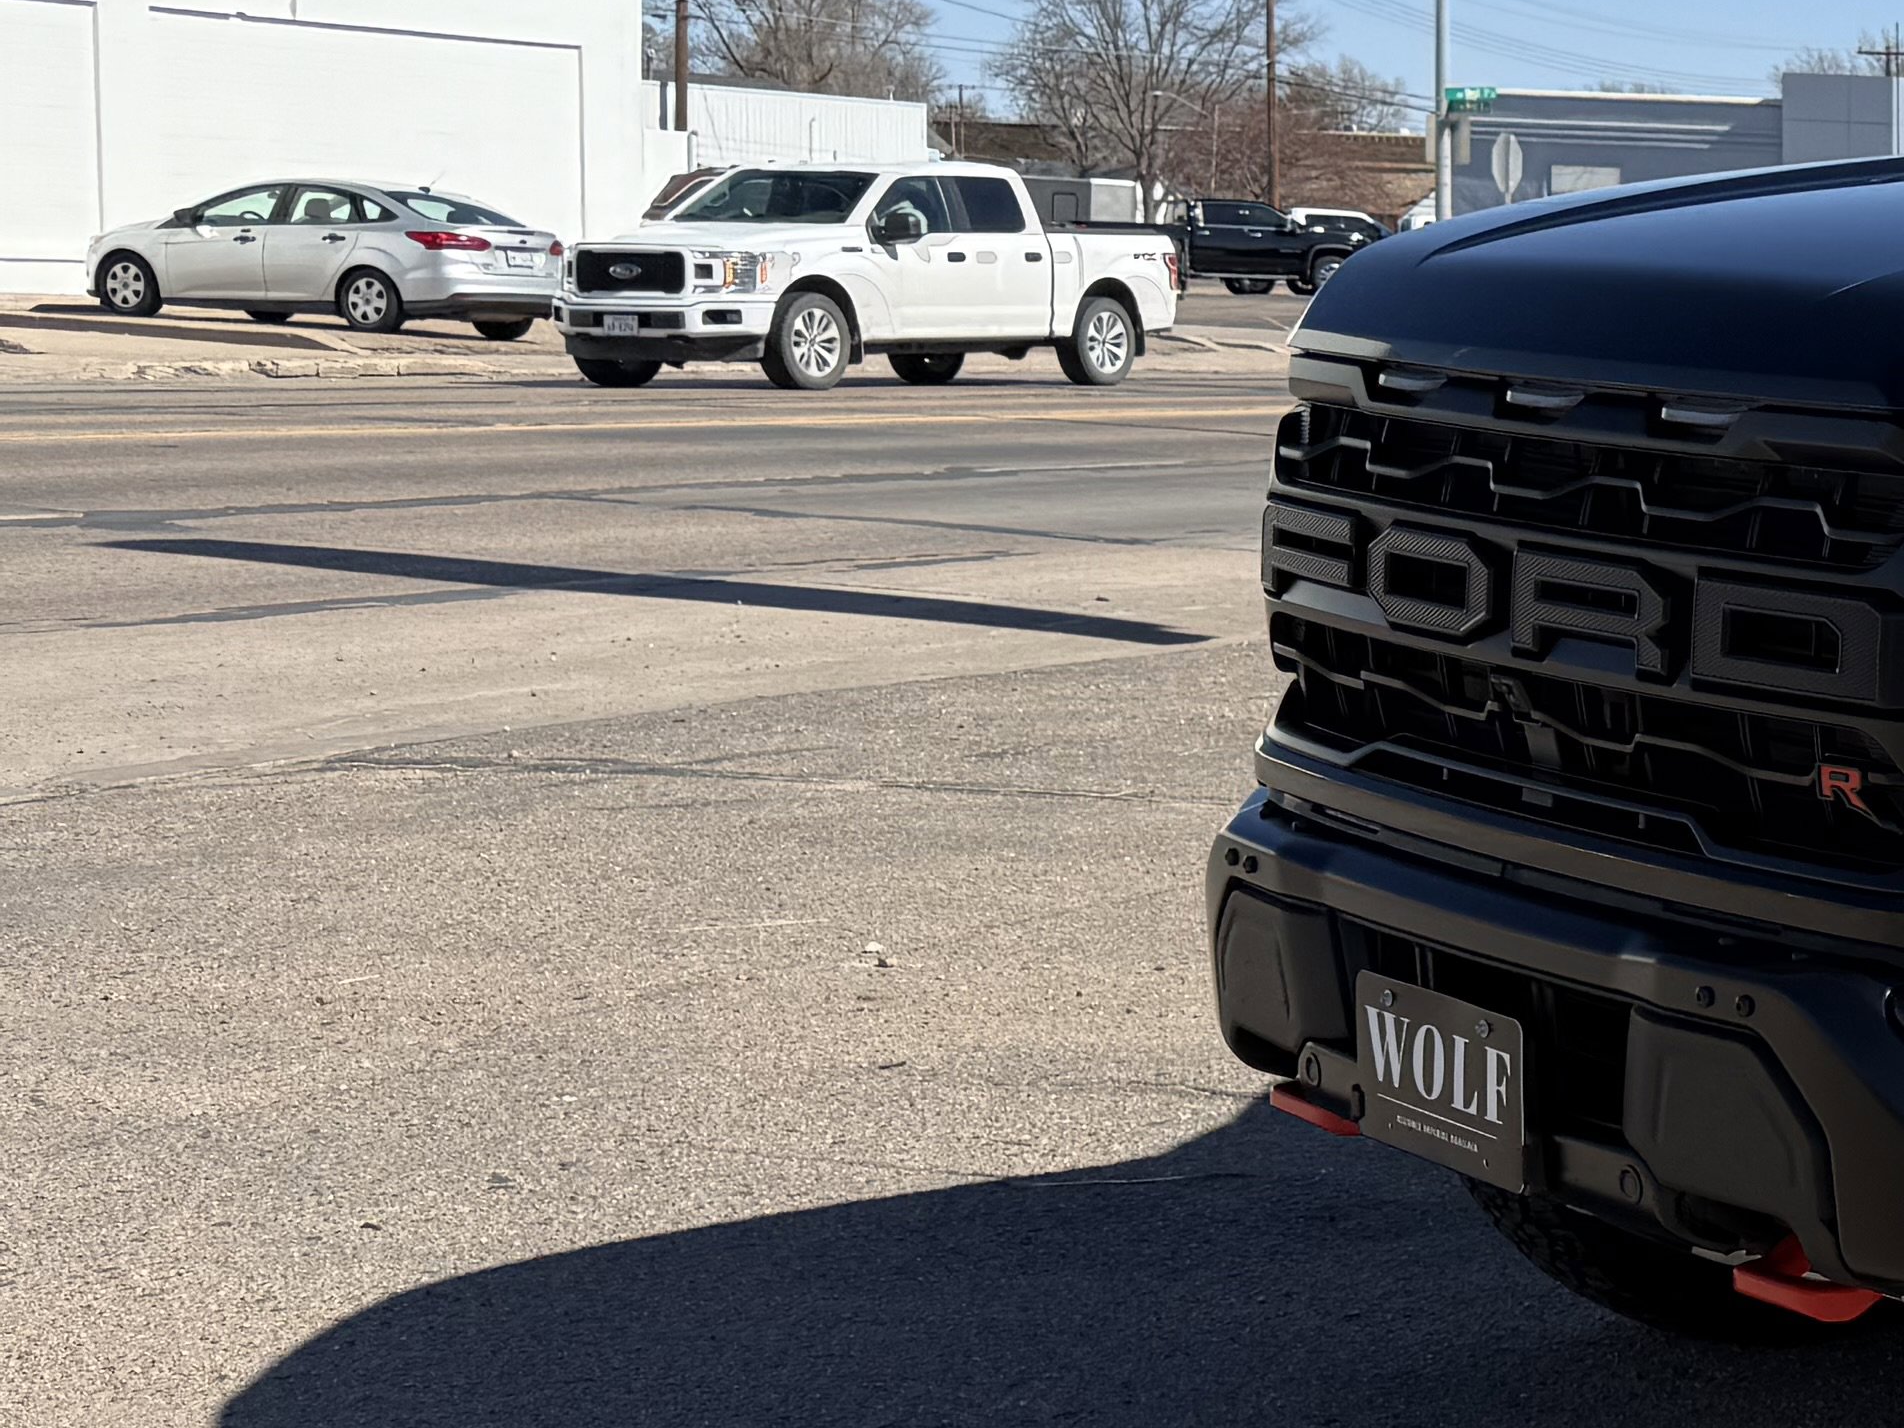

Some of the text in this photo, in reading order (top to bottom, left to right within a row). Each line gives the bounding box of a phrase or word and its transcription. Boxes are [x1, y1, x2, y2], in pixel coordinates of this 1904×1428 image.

[1262, 501, 1885, 704] FORD
[1817, 764, 1874, 815] R
[1364, 1004, 1512, 1125] WOLF
